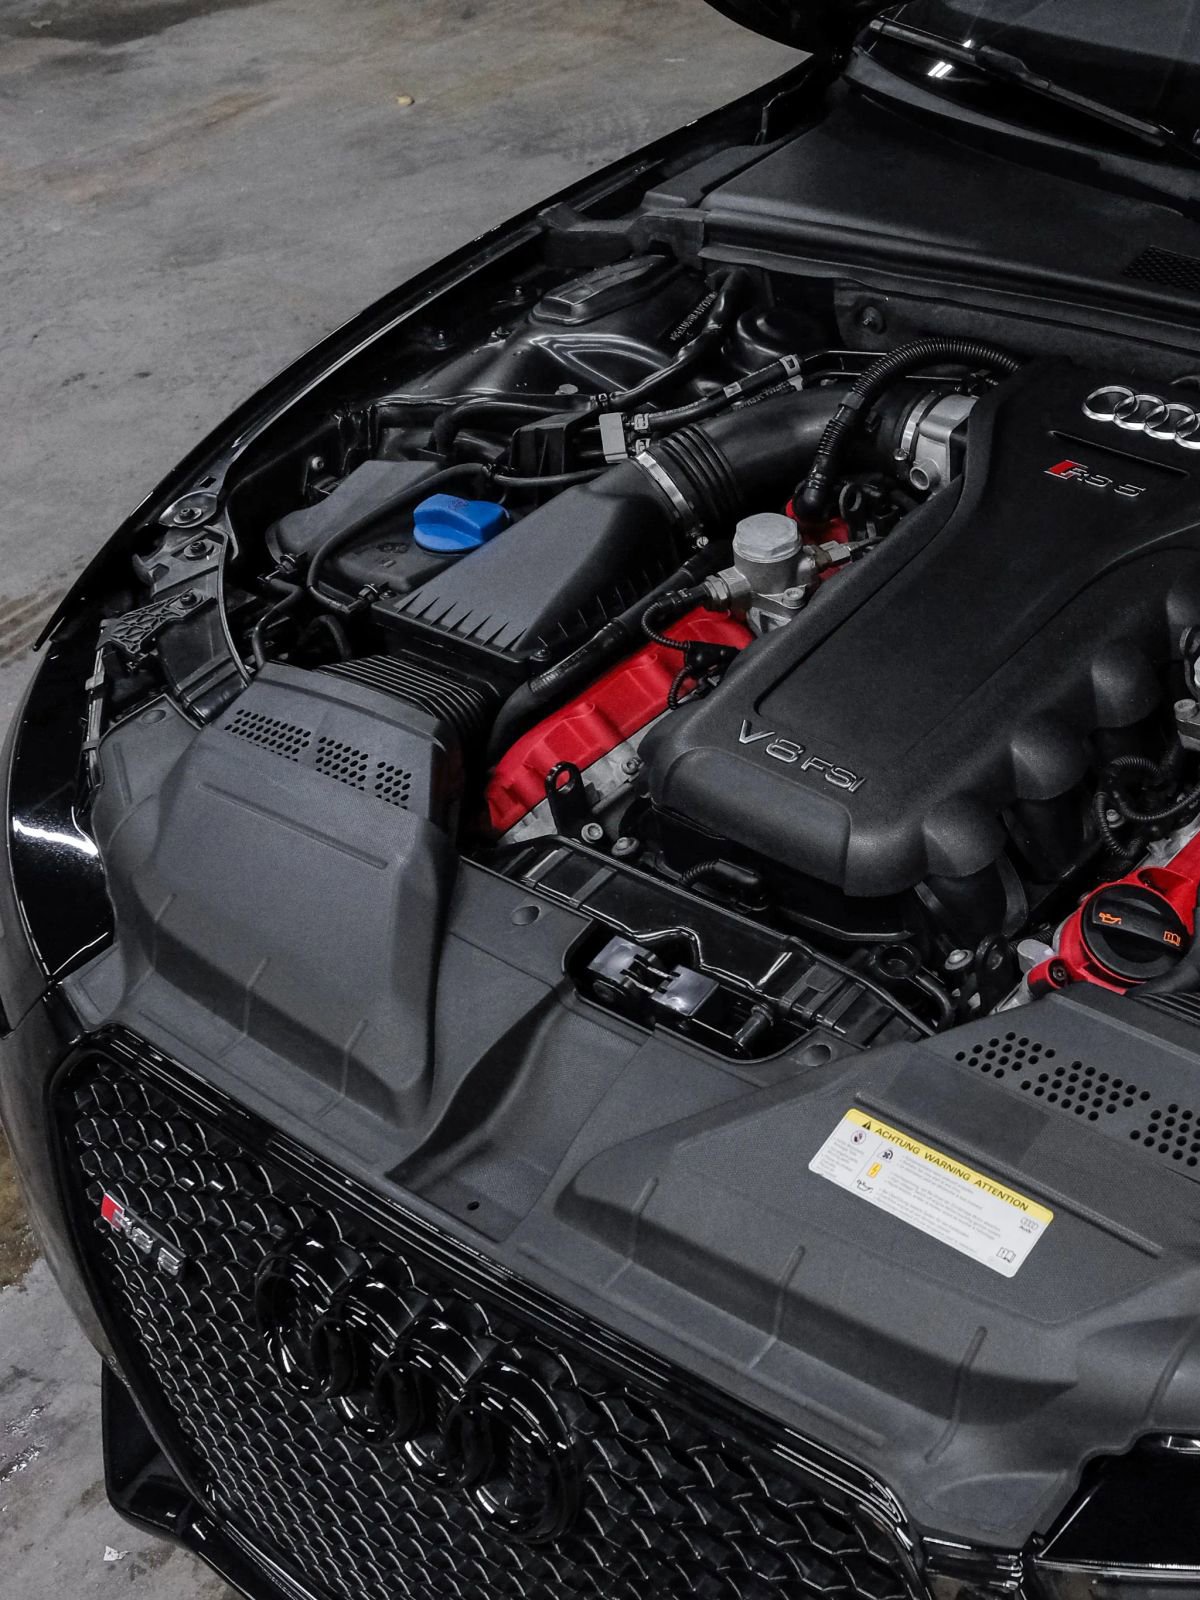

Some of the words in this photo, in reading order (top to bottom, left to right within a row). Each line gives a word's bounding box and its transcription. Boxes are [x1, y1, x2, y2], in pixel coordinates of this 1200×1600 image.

[738, 719, 805, 763] V8
[801, 757, 866, 793] FSI
[875, 1127, 920, 1155] ACHTUNG
[924, 1152, 971, 1181] WARNING
[974, 1179, 1029, 1211] ATTENTION
